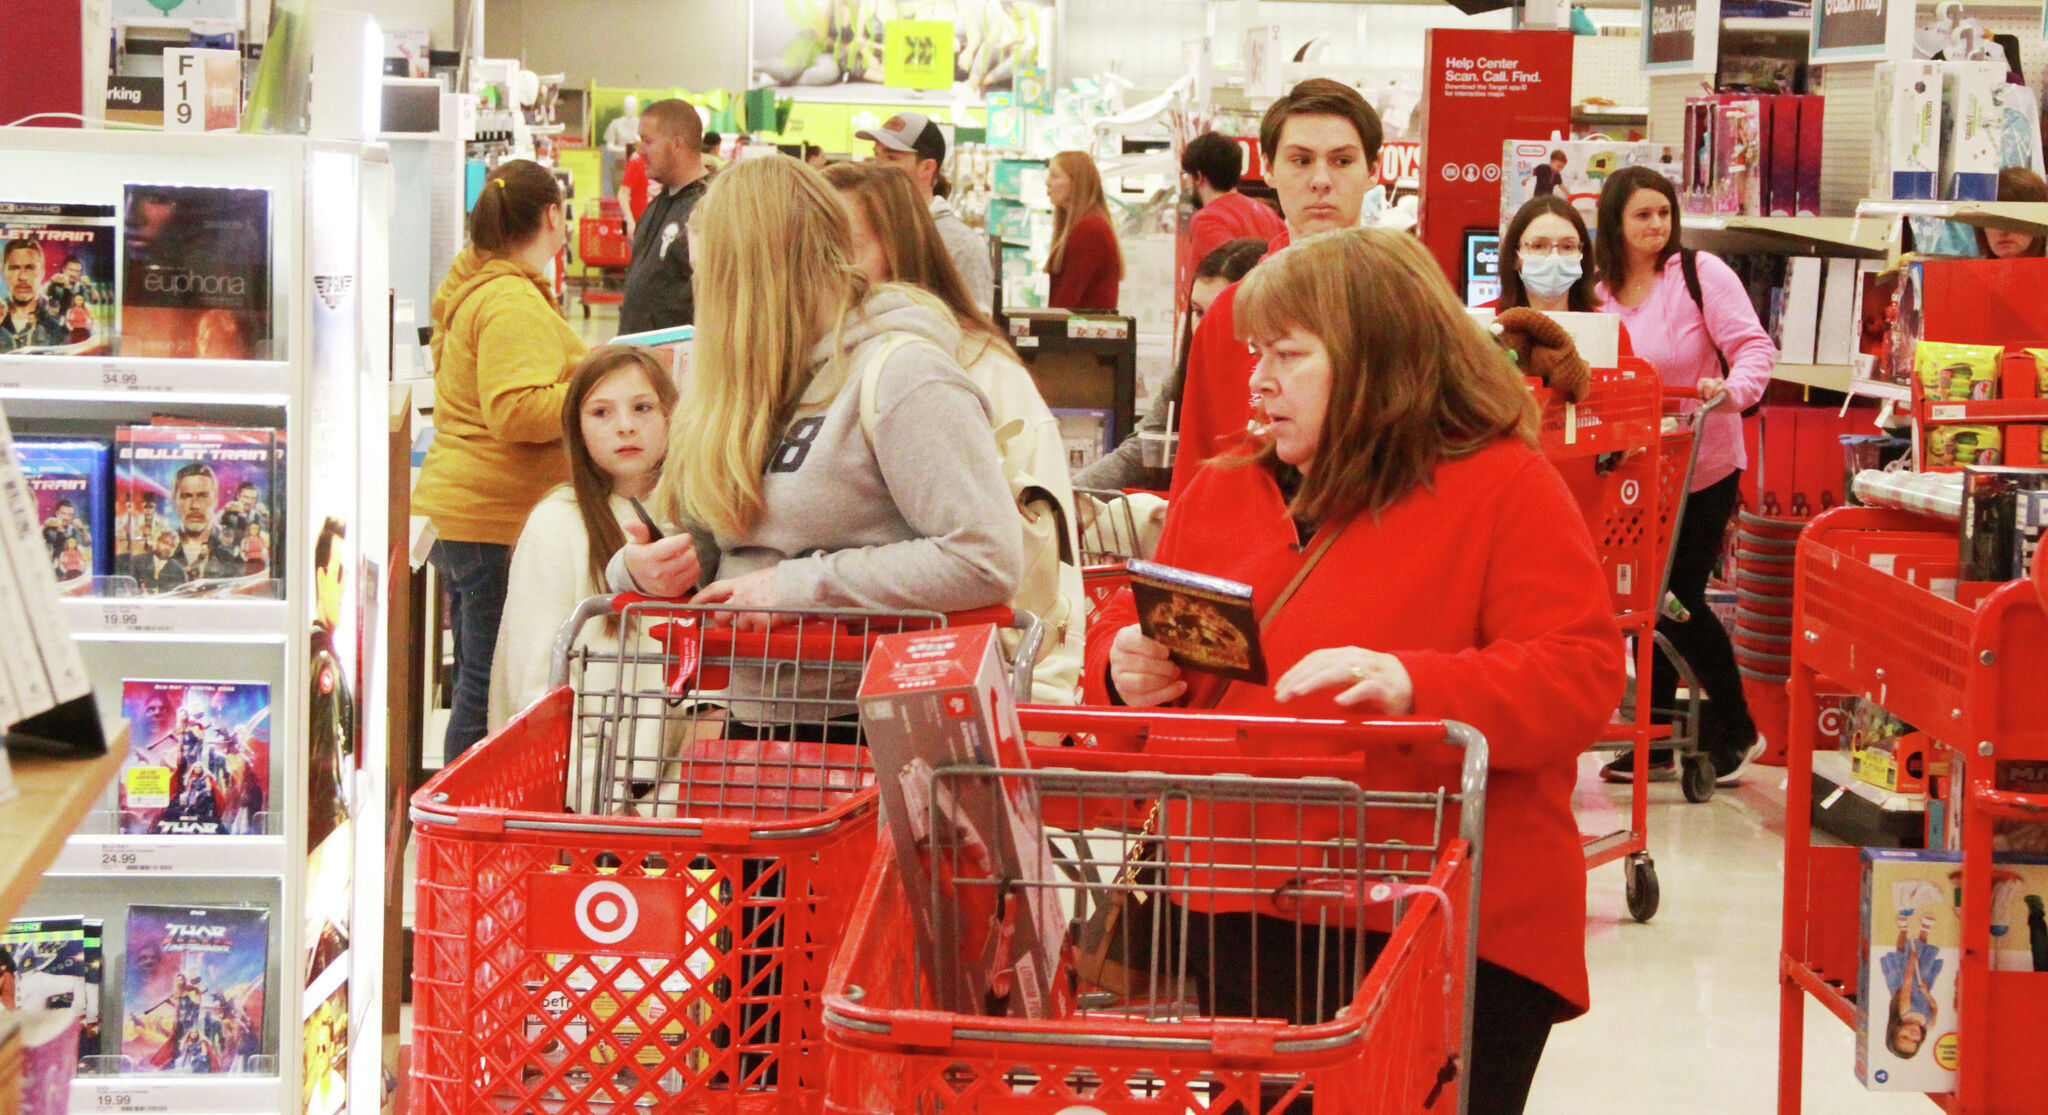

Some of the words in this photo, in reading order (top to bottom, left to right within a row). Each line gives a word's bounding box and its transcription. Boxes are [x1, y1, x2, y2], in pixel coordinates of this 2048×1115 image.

[1445, 57, 1474, 71] Help
[1477, 57, 1519, 69] Center
[1445, 70, 1479, 82] Scan.
[1482, 70, 1509, 82] Call.
[1512, 71, 1542, 82] Find.
[1379, 144, 1420, 181] OYS
[36, 230, 95, 242] TRAIN
[144, 269, 245, 297] euphoria
[103, 373, 137, 385] 34.99
[135, 449, 207, 460] BULLET
[208, 450, 267, 461] TRAIN
[31, 480, 87, 490] TRAIN
[104, 614, 137, 625] 19.99
[102, 853, 136, 864] 24.99
[98, 1095, 131, 1105] 19.99
